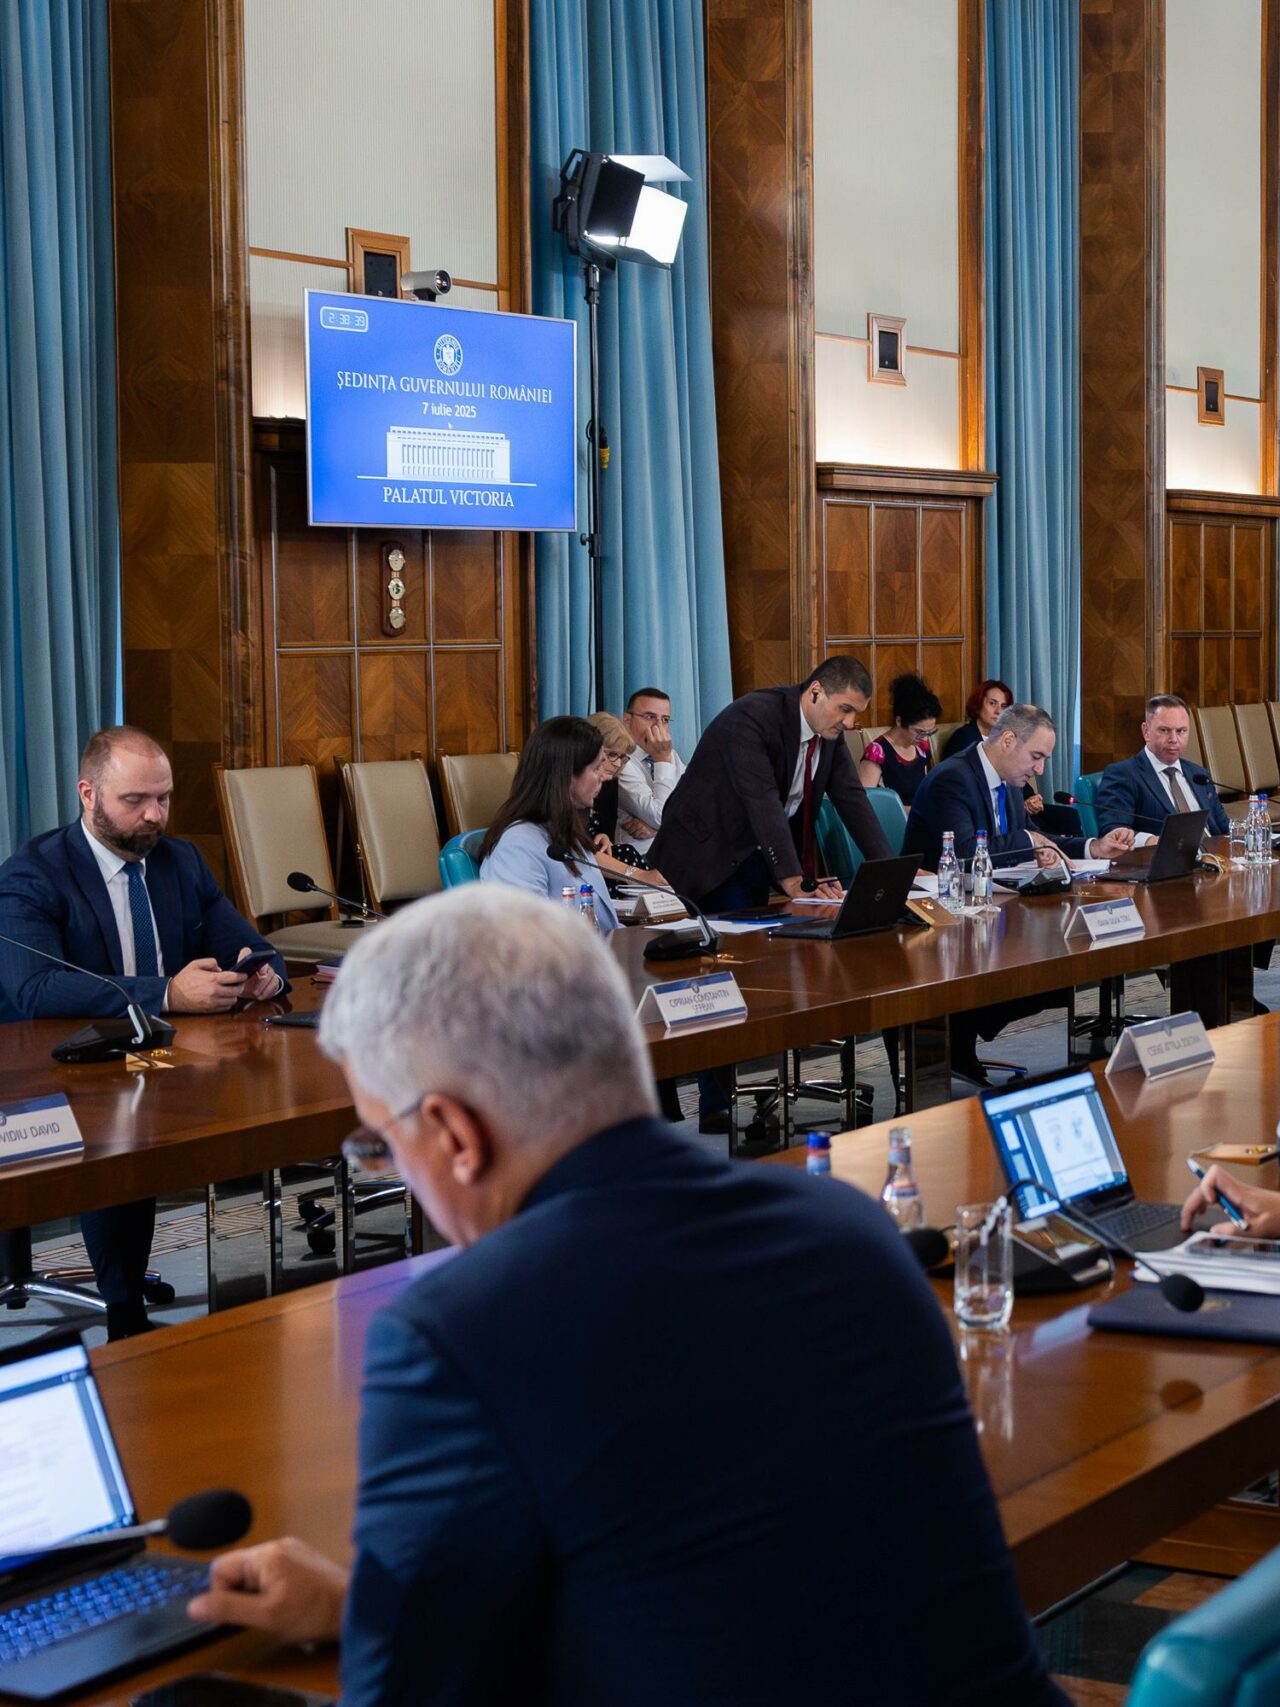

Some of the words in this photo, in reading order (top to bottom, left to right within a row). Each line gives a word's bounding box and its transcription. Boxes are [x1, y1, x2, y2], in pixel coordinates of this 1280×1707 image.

[336, 370, 398, 393] ȘEDINȚA
[400, 376, 485, 398] GUVERNULUI
[489, 384, 552, 404] ROMÂNIEI
[422, 401, 429, 415] 7
[431, 402, 453, 417] iulie
[454, 404, 477, 418] 2025
[383, 486, 448, 505] PALATUL
[449, 489, 515, 507] VICTORIA
[0, 1128, 28, 1143] VIDIU
[30, 1122, 60, 1138] DAVID
